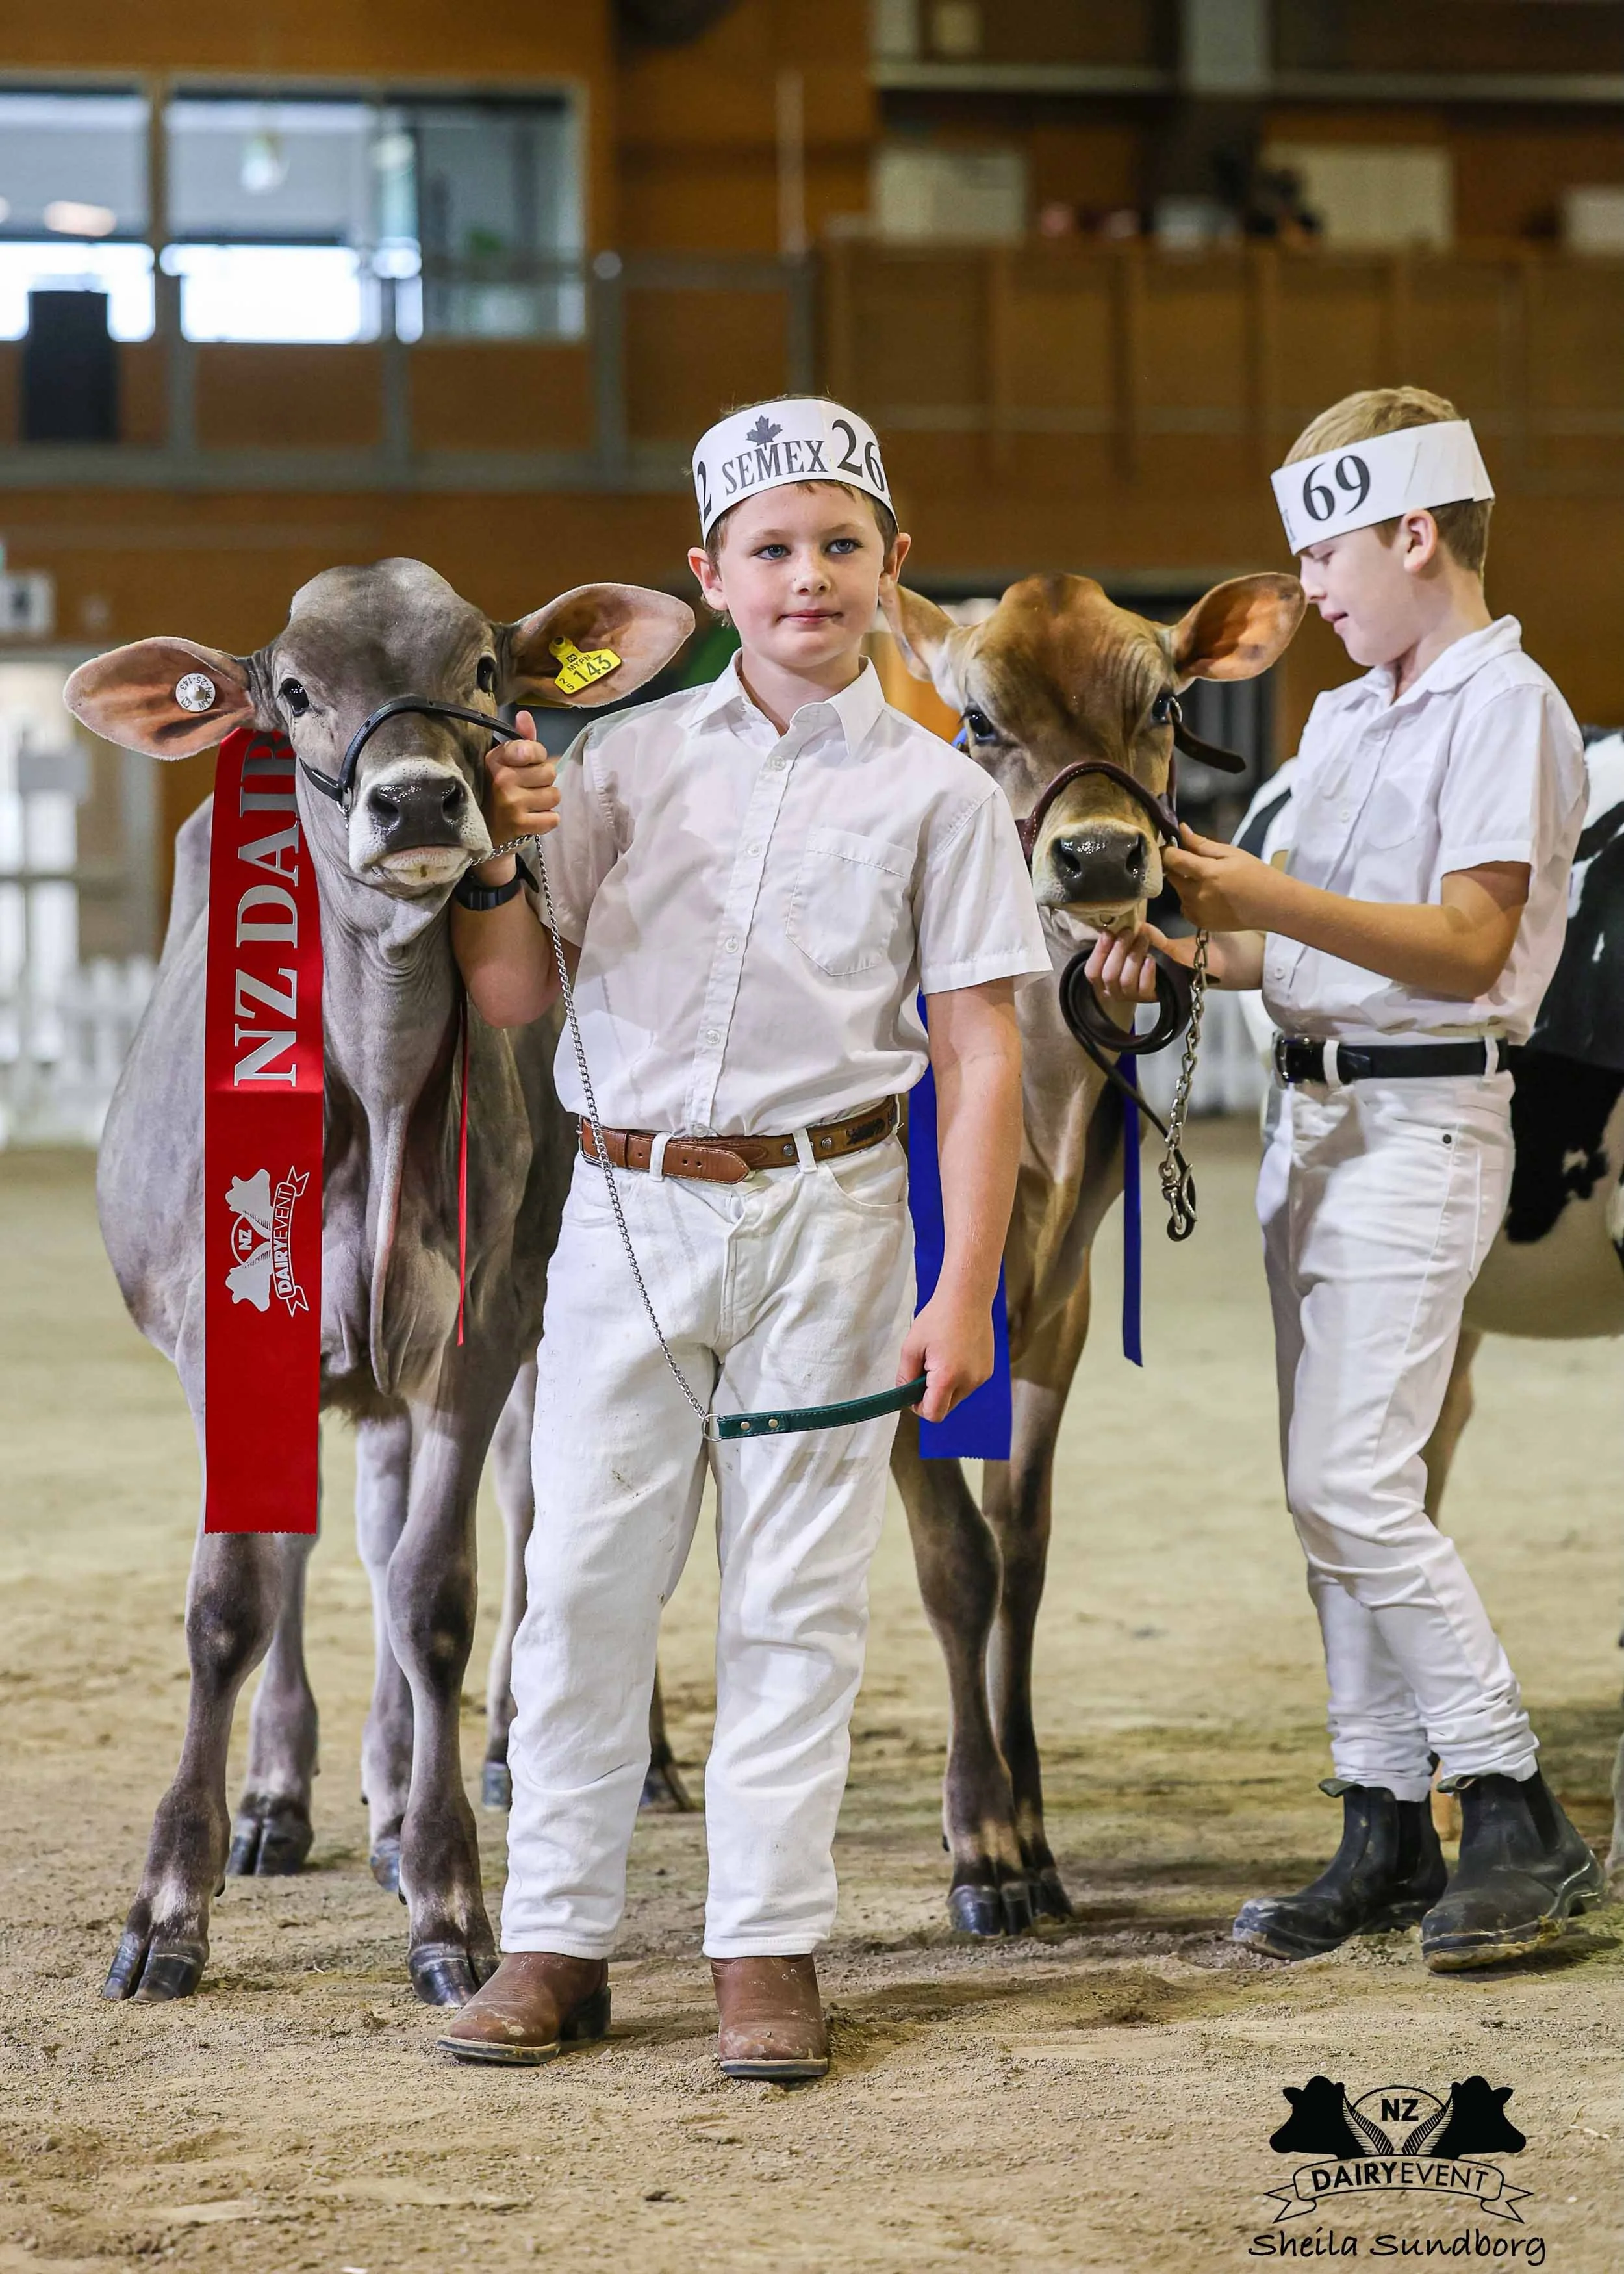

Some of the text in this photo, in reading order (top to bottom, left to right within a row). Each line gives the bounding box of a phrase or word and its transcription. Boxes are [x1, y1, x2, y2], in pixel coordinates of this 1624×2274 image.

[697, 461, 712, 524] 2
[722, 440, 830, 495] SEMEX
[1302, 455, 1370, 520] 69
[567, 654, 592, 671] MYPN
[573, 654, 611, 682] 143
[234, 968, 297, 1087] NZ
[238, 1229, 252, 1251] NZ
